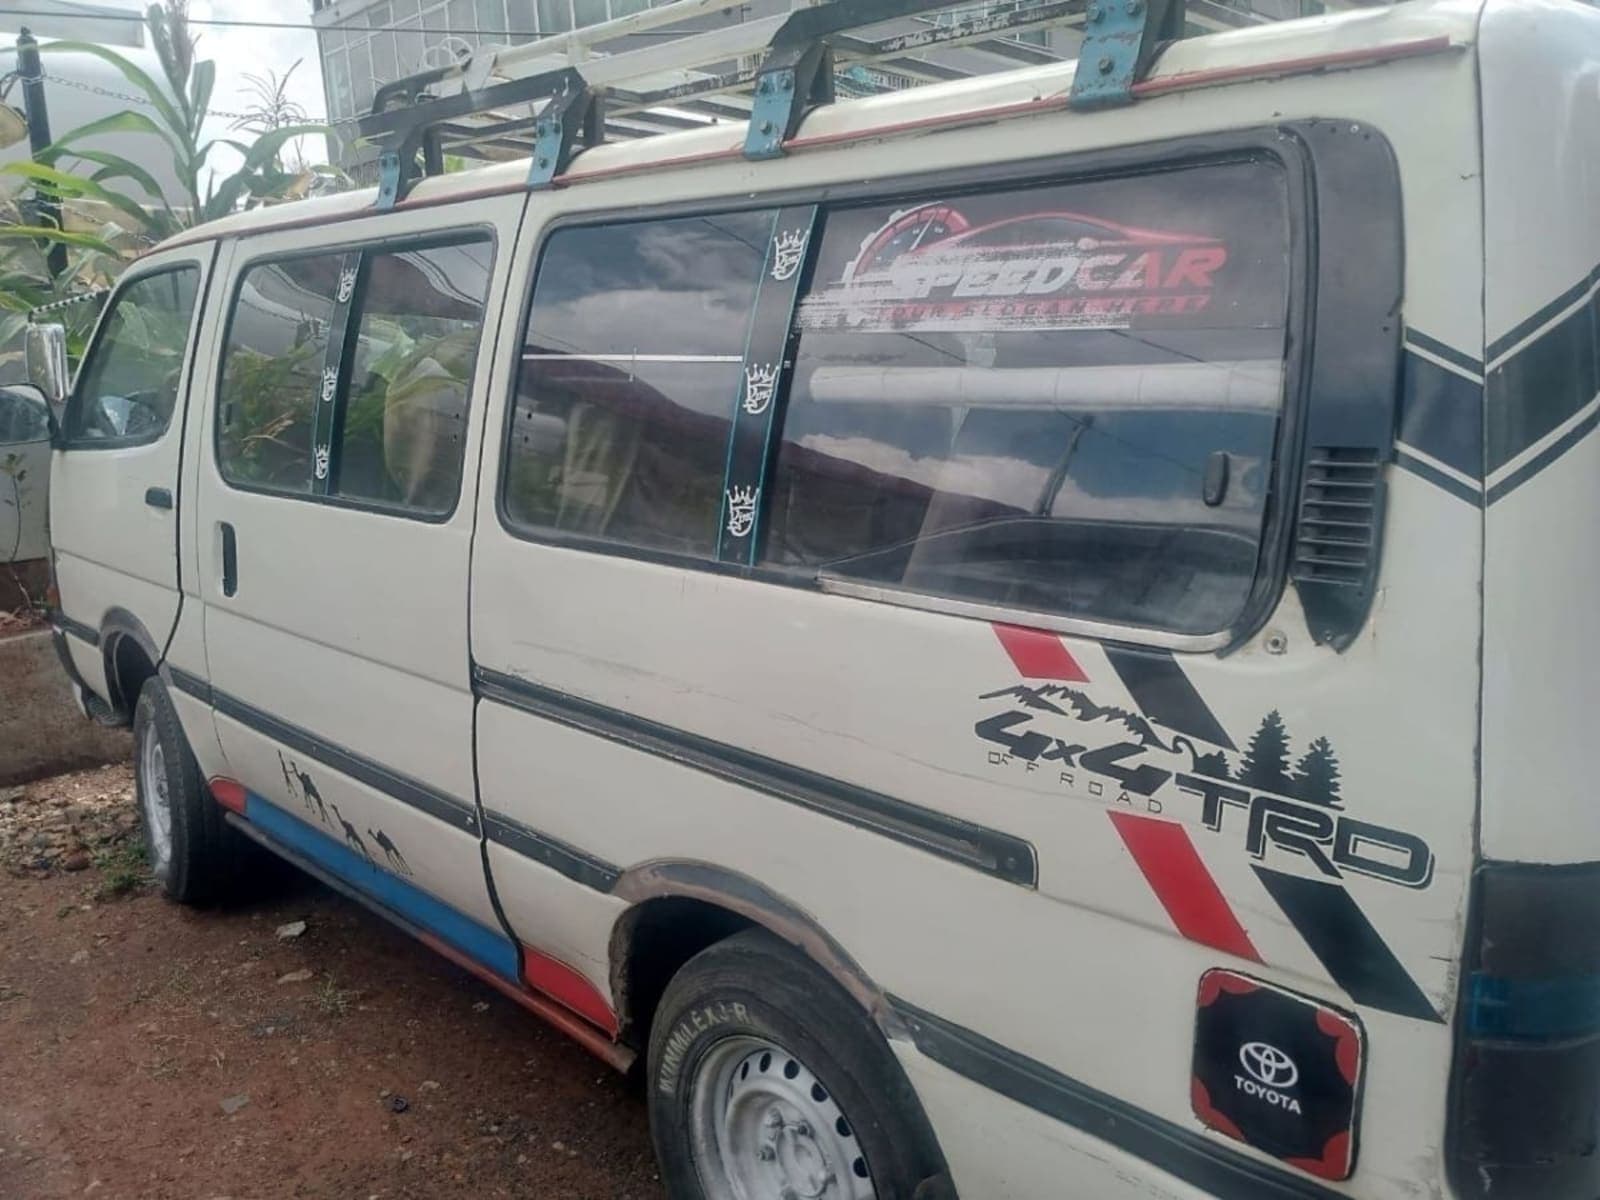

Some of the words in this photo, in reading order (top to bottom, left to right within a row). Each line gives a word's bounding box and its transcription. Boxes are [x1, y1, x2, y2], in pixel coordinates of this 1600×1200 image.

[1059, 771, 1163, 815] ROAD
[1175, 772, 1436, 890] TRD
[1233, 1074, 1302, 1115] TOYOTA
